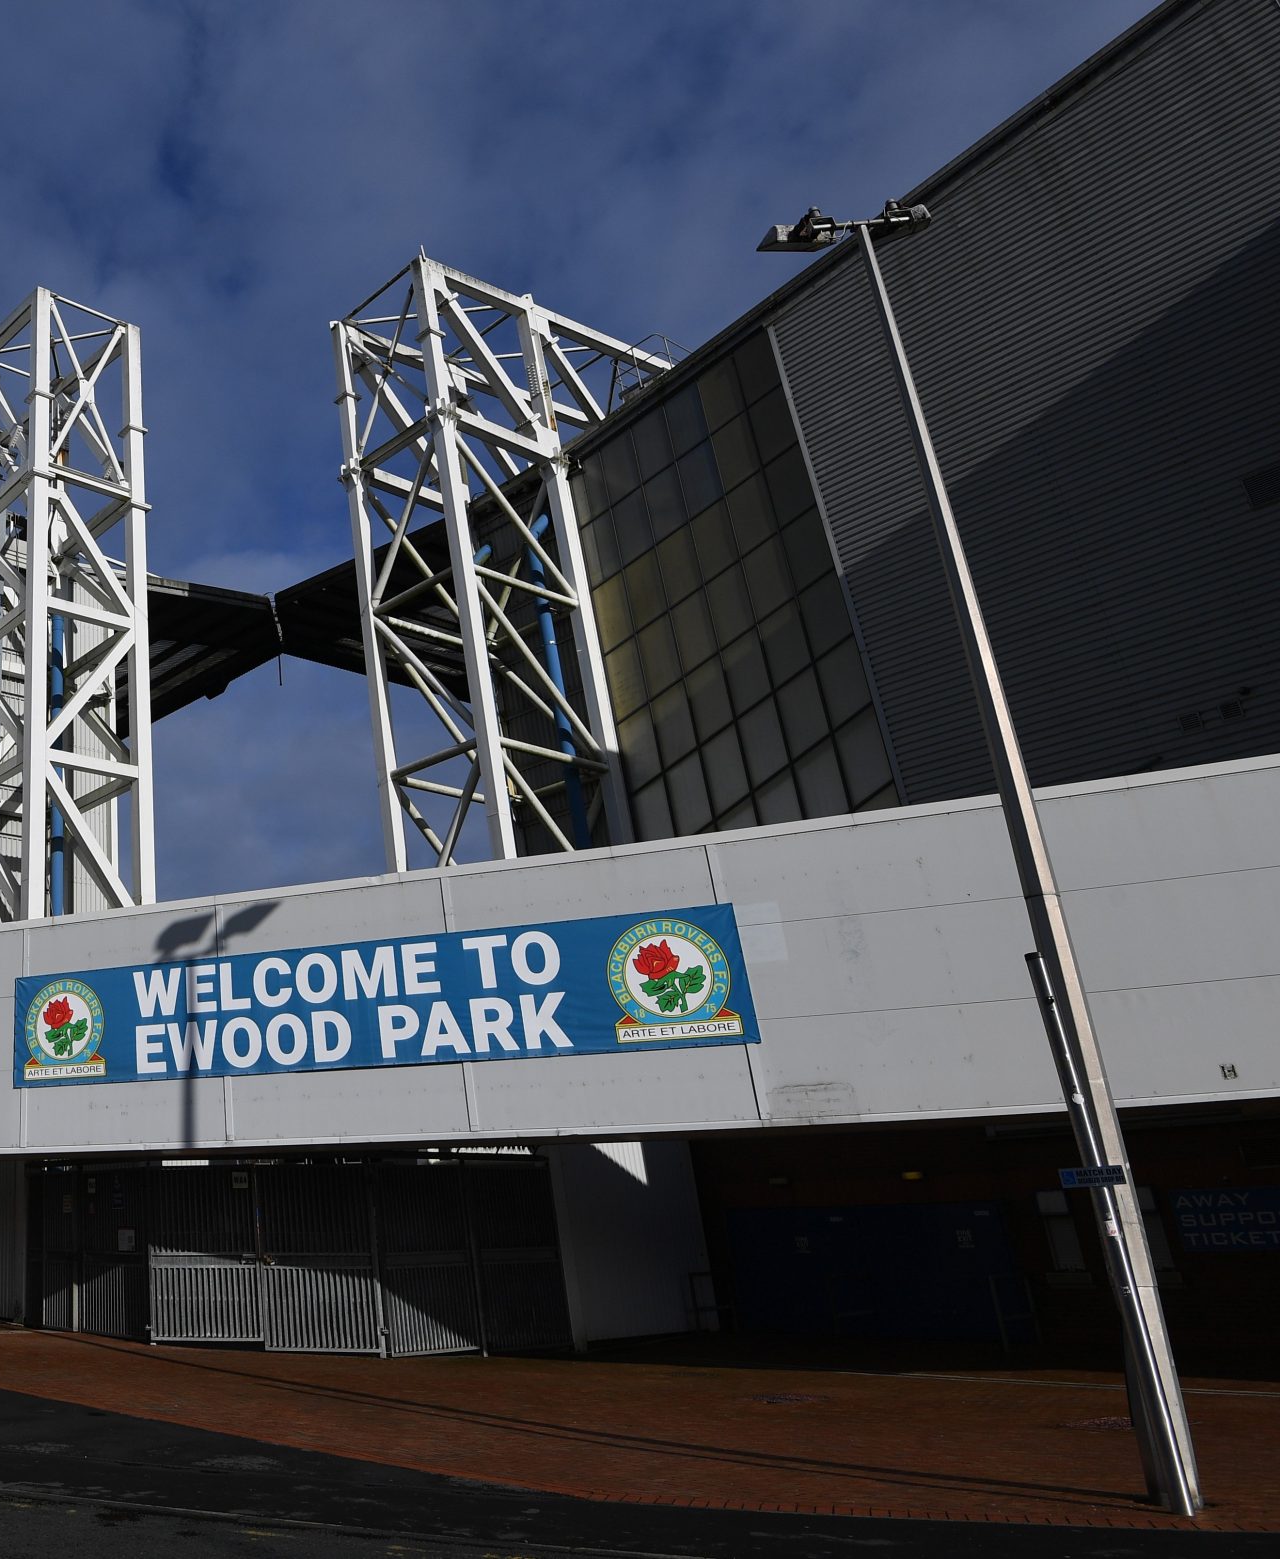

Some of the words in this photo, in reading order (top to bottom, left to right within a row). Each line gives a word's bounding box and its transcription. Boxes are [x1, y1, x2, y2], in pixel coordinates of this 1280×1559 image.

[609, 922, 657, 1004] BLACKBURN
[662, 921, 722, 963] ROVERS
[132, 941, 442, 1018] WELCOME
[461, 931, 561, 989] TO
[26, 981, 63, 1049] BLACKBURN
[66, 981, 101, 1016] ROVERS
[134, 1009, 352, 1074] EWOOD
[377, 991, 575, 1059] PARK
[622, 1028, 657, 1039] ARTE
[660, 1026, 677, 1036] ET
[680, 1022, 736, 1034] LABORE
[27, 1068, 51, 1077] ARTE
[52, 1067, 64, 1075] ET
[65, 1065, 102, 1074] LABORE
[1076, 1168, 1104, 1177] MATCH
[1106, 1168, 1121, 1176] DAY
[1176, 1192, 1249, 1208] AWAY
[1180, 1211, 1280, 1227] SUPPO
